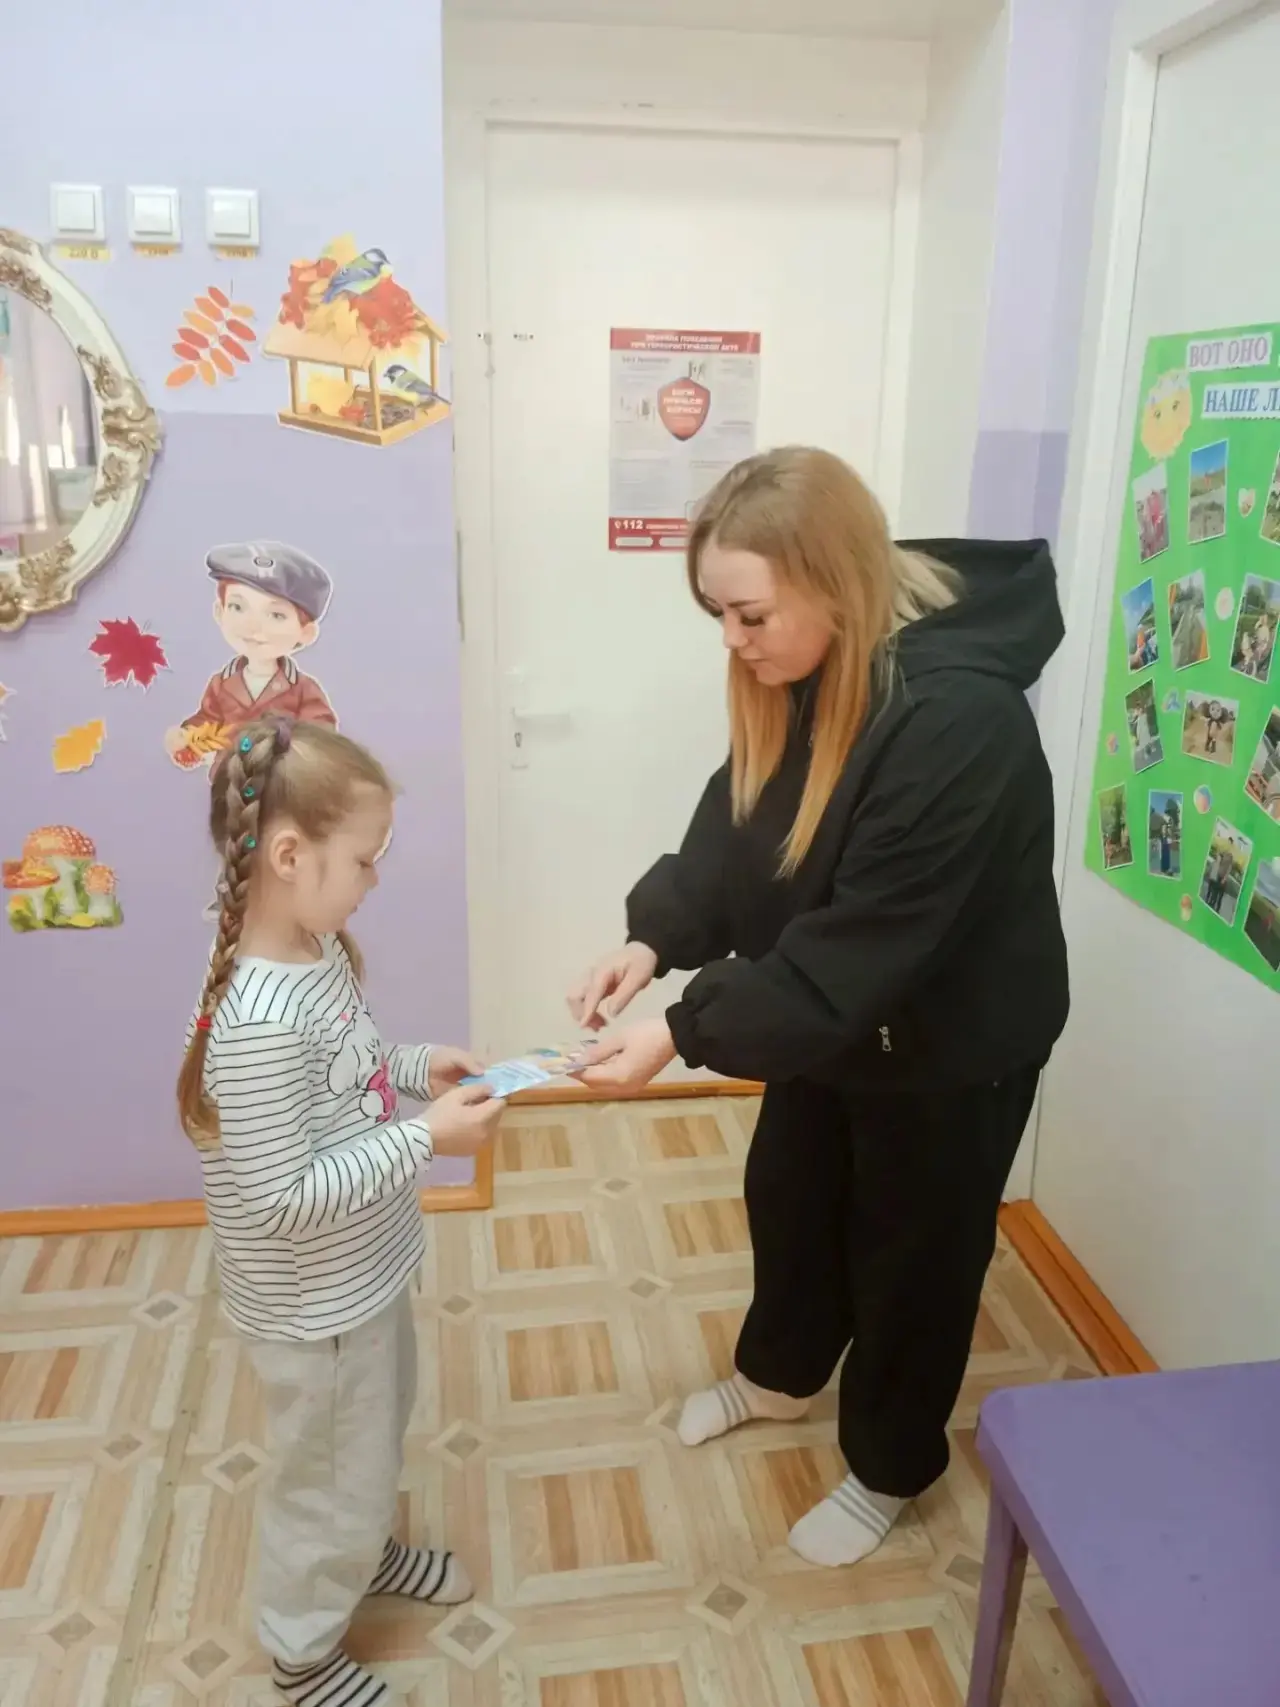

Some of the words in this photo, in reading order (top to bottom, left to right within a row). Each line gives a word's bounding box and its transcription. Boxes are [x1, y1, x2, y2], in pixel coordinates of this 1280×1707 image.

[1189, 341, 1224, 368] ВОТ
[1228, 336, 1269, 364] ОНО
[1204, 387, 1260, 413] НАШЕ
[623, 520, 644, 530] 112
